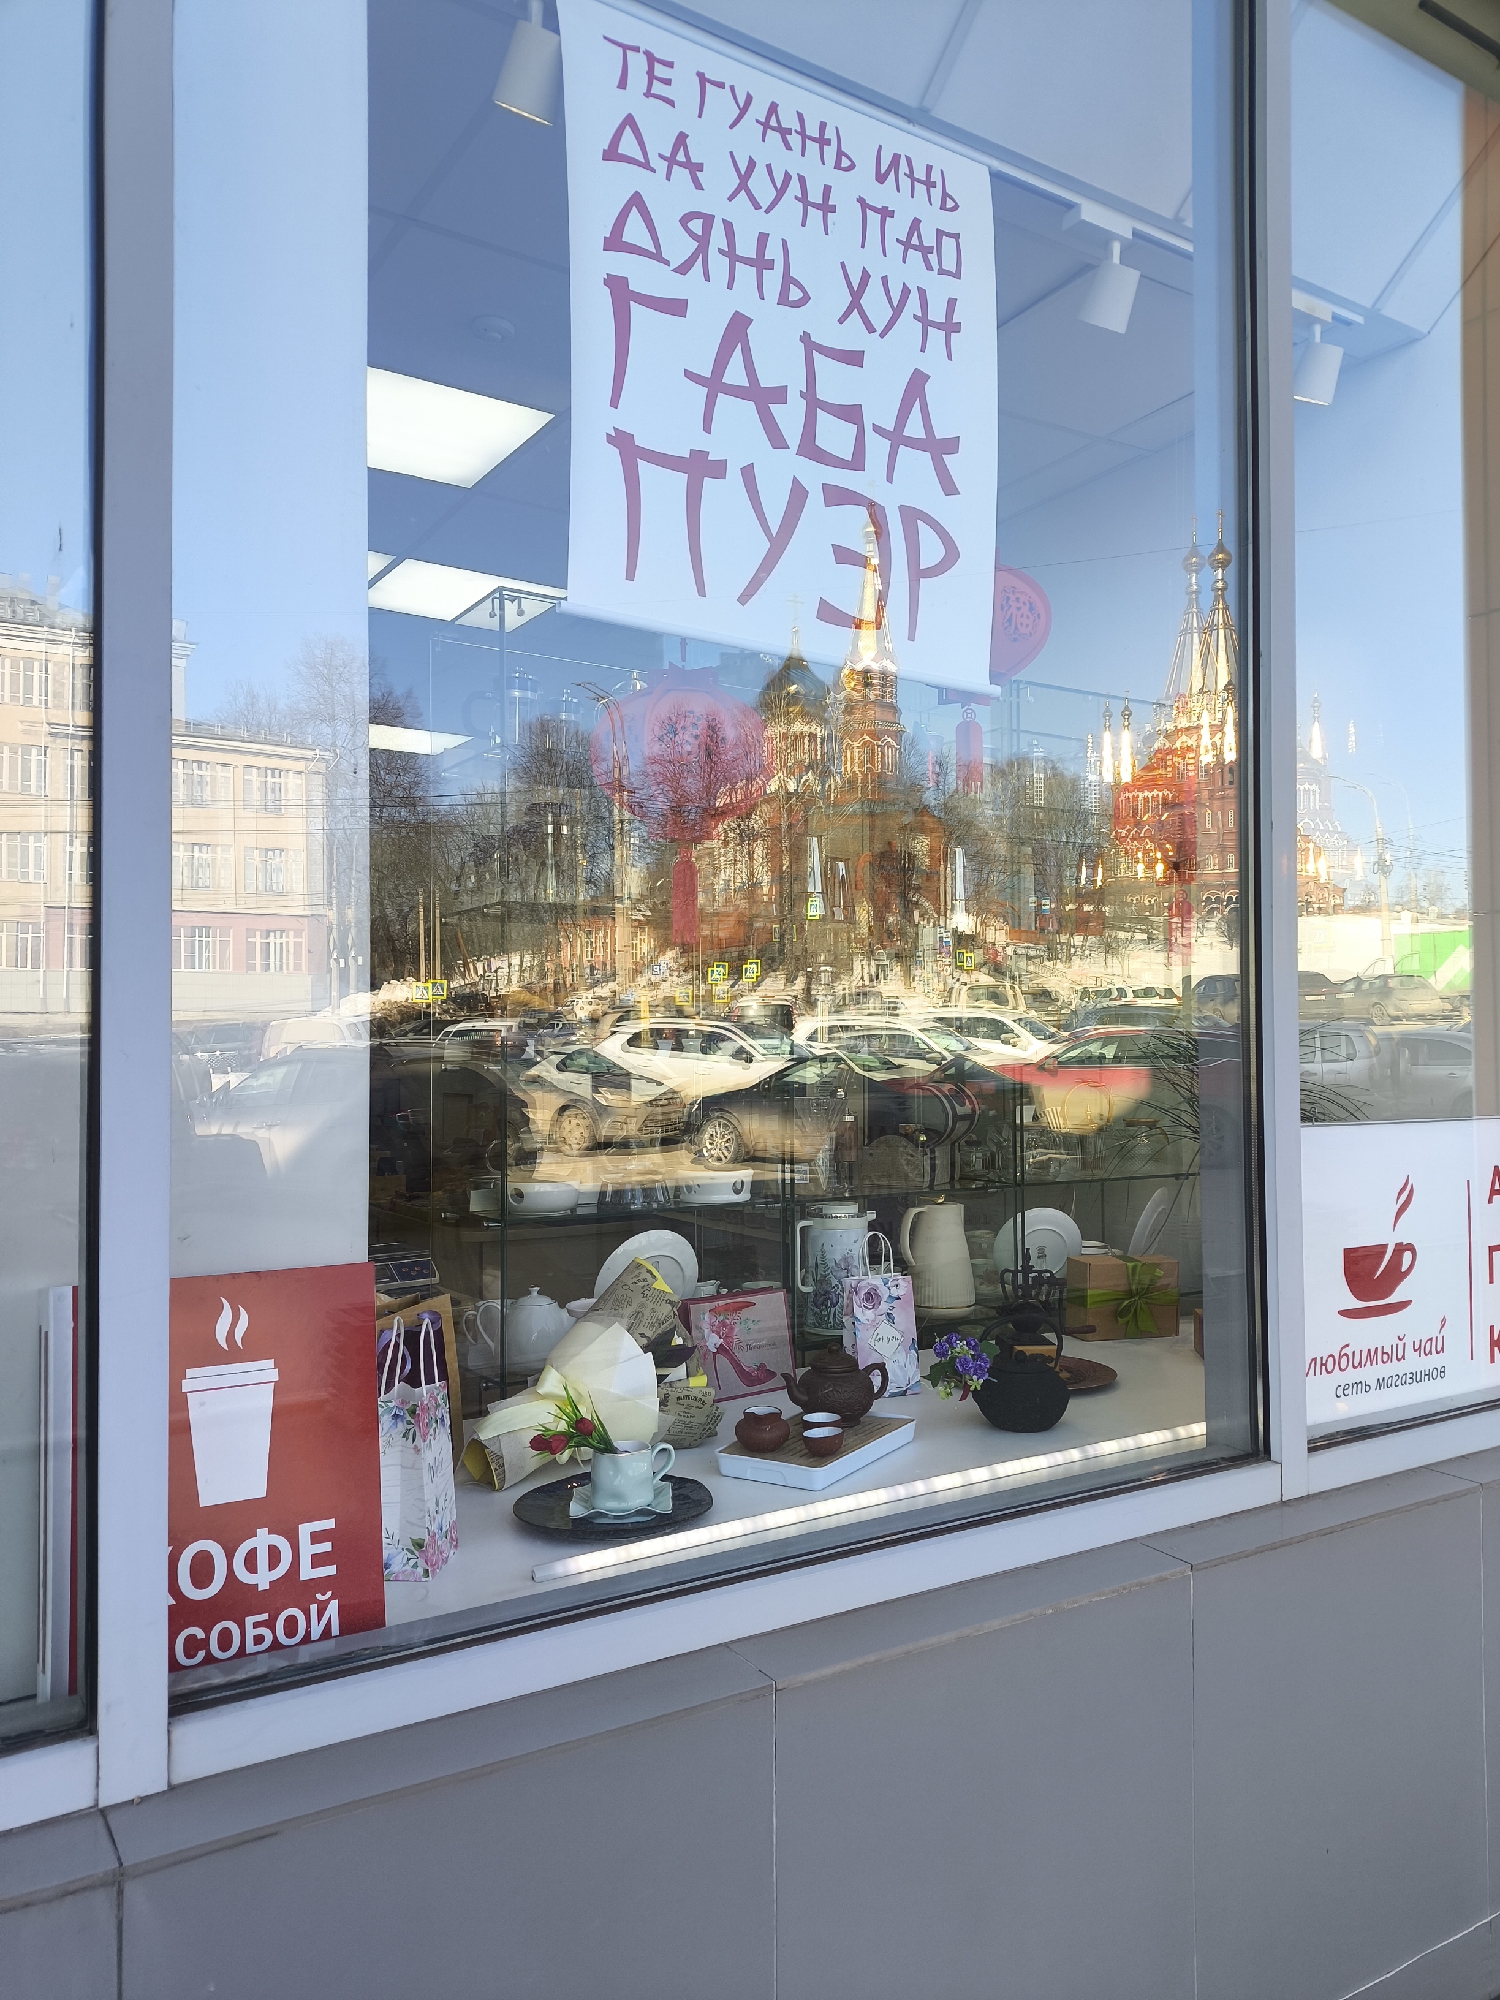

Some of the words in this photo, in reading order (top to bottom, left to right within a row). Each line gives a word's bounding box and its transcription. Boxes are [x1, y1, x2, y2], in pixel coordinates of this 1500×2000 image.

[602, 113, 705, 191] ДА
[727, 150, 837, 236] ХУН
[856, 195, 962, 280] ПАО
[603, 34, 676, 109] ТЕ
[696, 70, 857, 172] ГУАНЬ
[875, 144, 961, 213] ИНЬ
[603, 190, 812, 309] ДЯНЬ
[837, 261, 962, 361] ХУН
[603, 273, 961, 497] ГАБА
[605, 426, 961, 642] ПУЭР
[1305, 1333, 1406, 1378] любимый
[1412, 1316, 1447, 1358] чай
[1335, 1378, 1371, 1398] сеть
[1375, 1365, 1446, 1391] магазинов
[168, 1518, 337, 1605] ОФЕ
[175, 1591, 340, 1667] СОБОЙ
